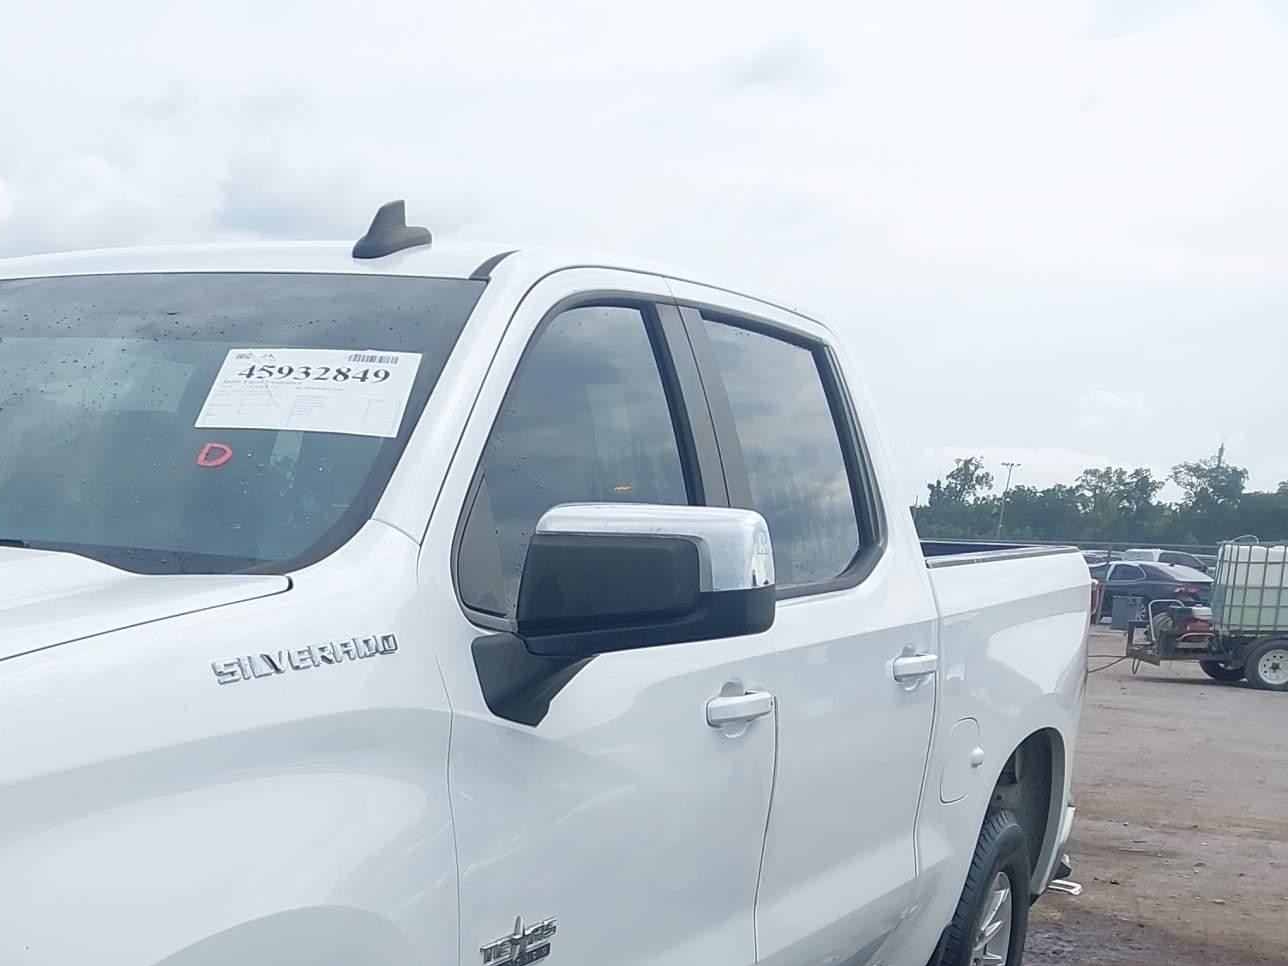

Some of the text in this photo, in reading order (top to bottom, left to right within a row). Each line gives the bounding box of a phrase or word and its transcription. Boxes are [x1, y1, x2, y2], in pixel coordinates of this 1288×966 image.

[238, 364, 391, 383] 45932849
[197, 443, 232, 467] D
[211, 633, 399, 685] SILVERADO
